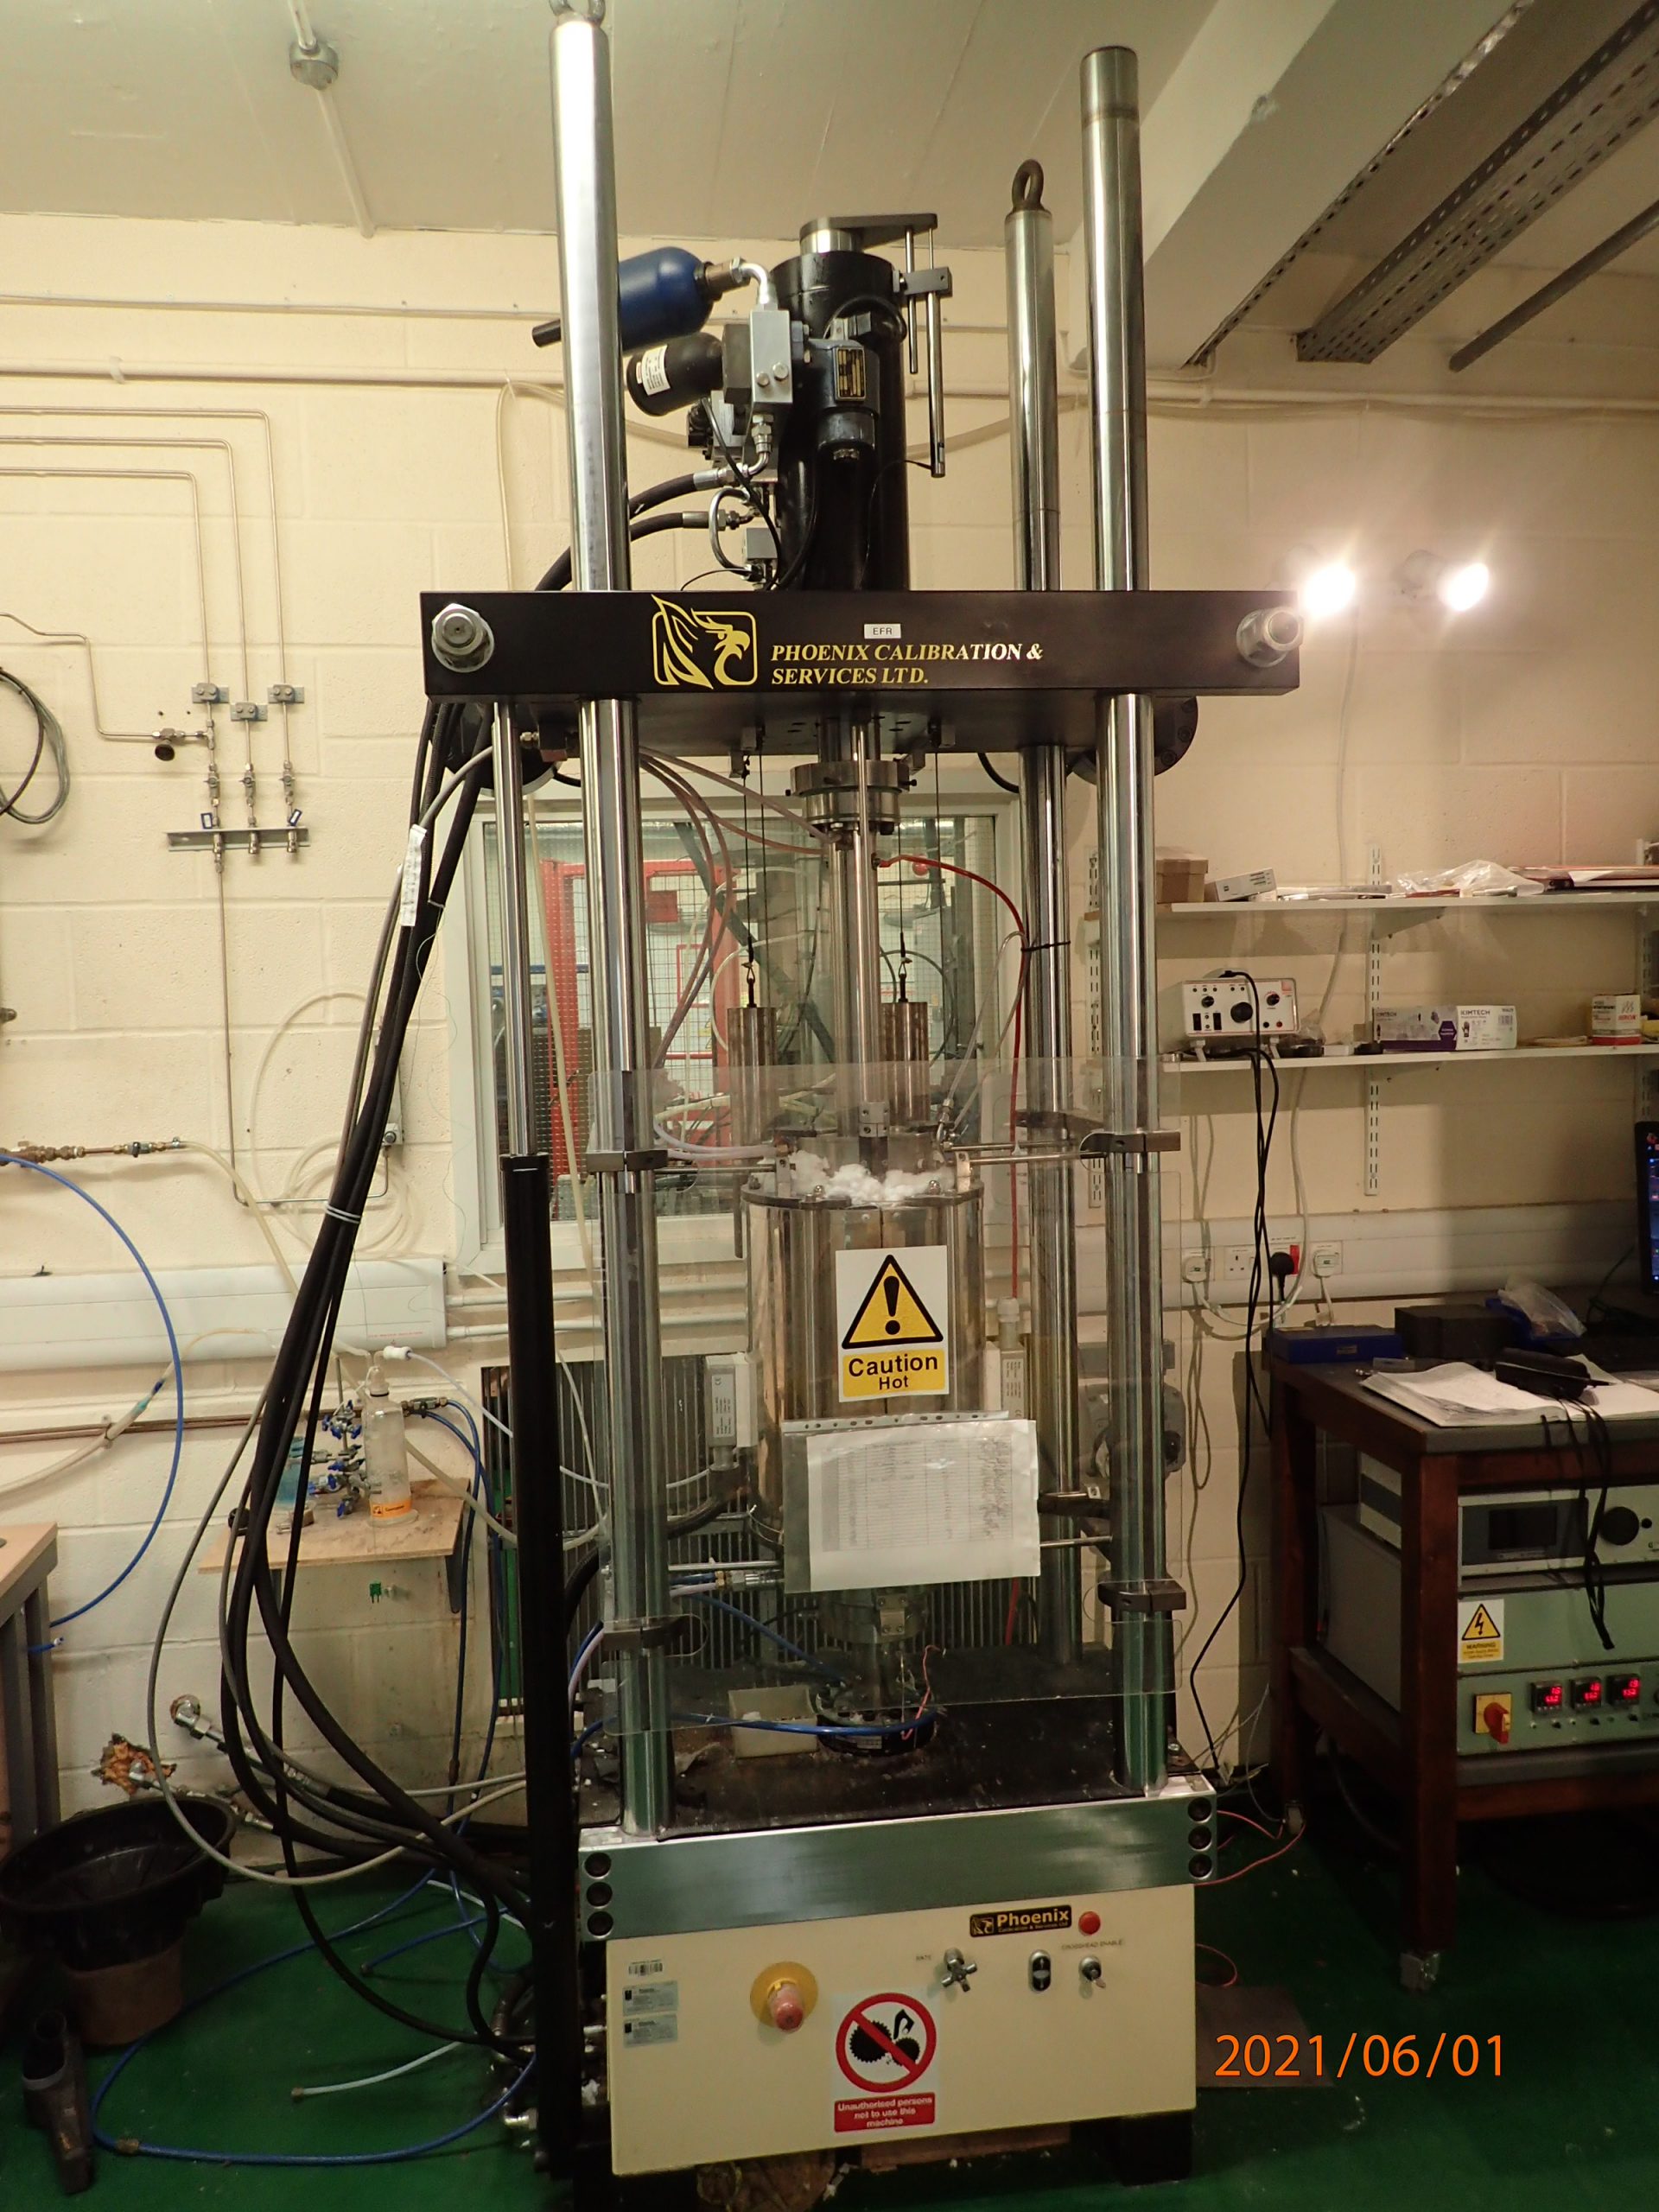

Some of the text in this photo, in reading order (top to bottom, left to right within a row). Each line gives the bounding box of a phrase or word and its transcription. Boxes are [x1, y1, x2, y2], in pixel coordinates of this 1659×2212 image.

[873, 626, 893, 636] EFR
[771, 643, 1044, 662] PHOENIX CALIBRATION &
[771, 667, 930, 685] SERVICES LTD.
[848, 1353, 938, 1377] Caution
[879, 1375, 909, 1390] Hot
[996, 1908, 1070, 1928] Phoenix
[837, 2097, 933, 2112] Unauthorised persons
[899, 2107, 917, 2116] this
[866, 2118, 904, 2128] machine
